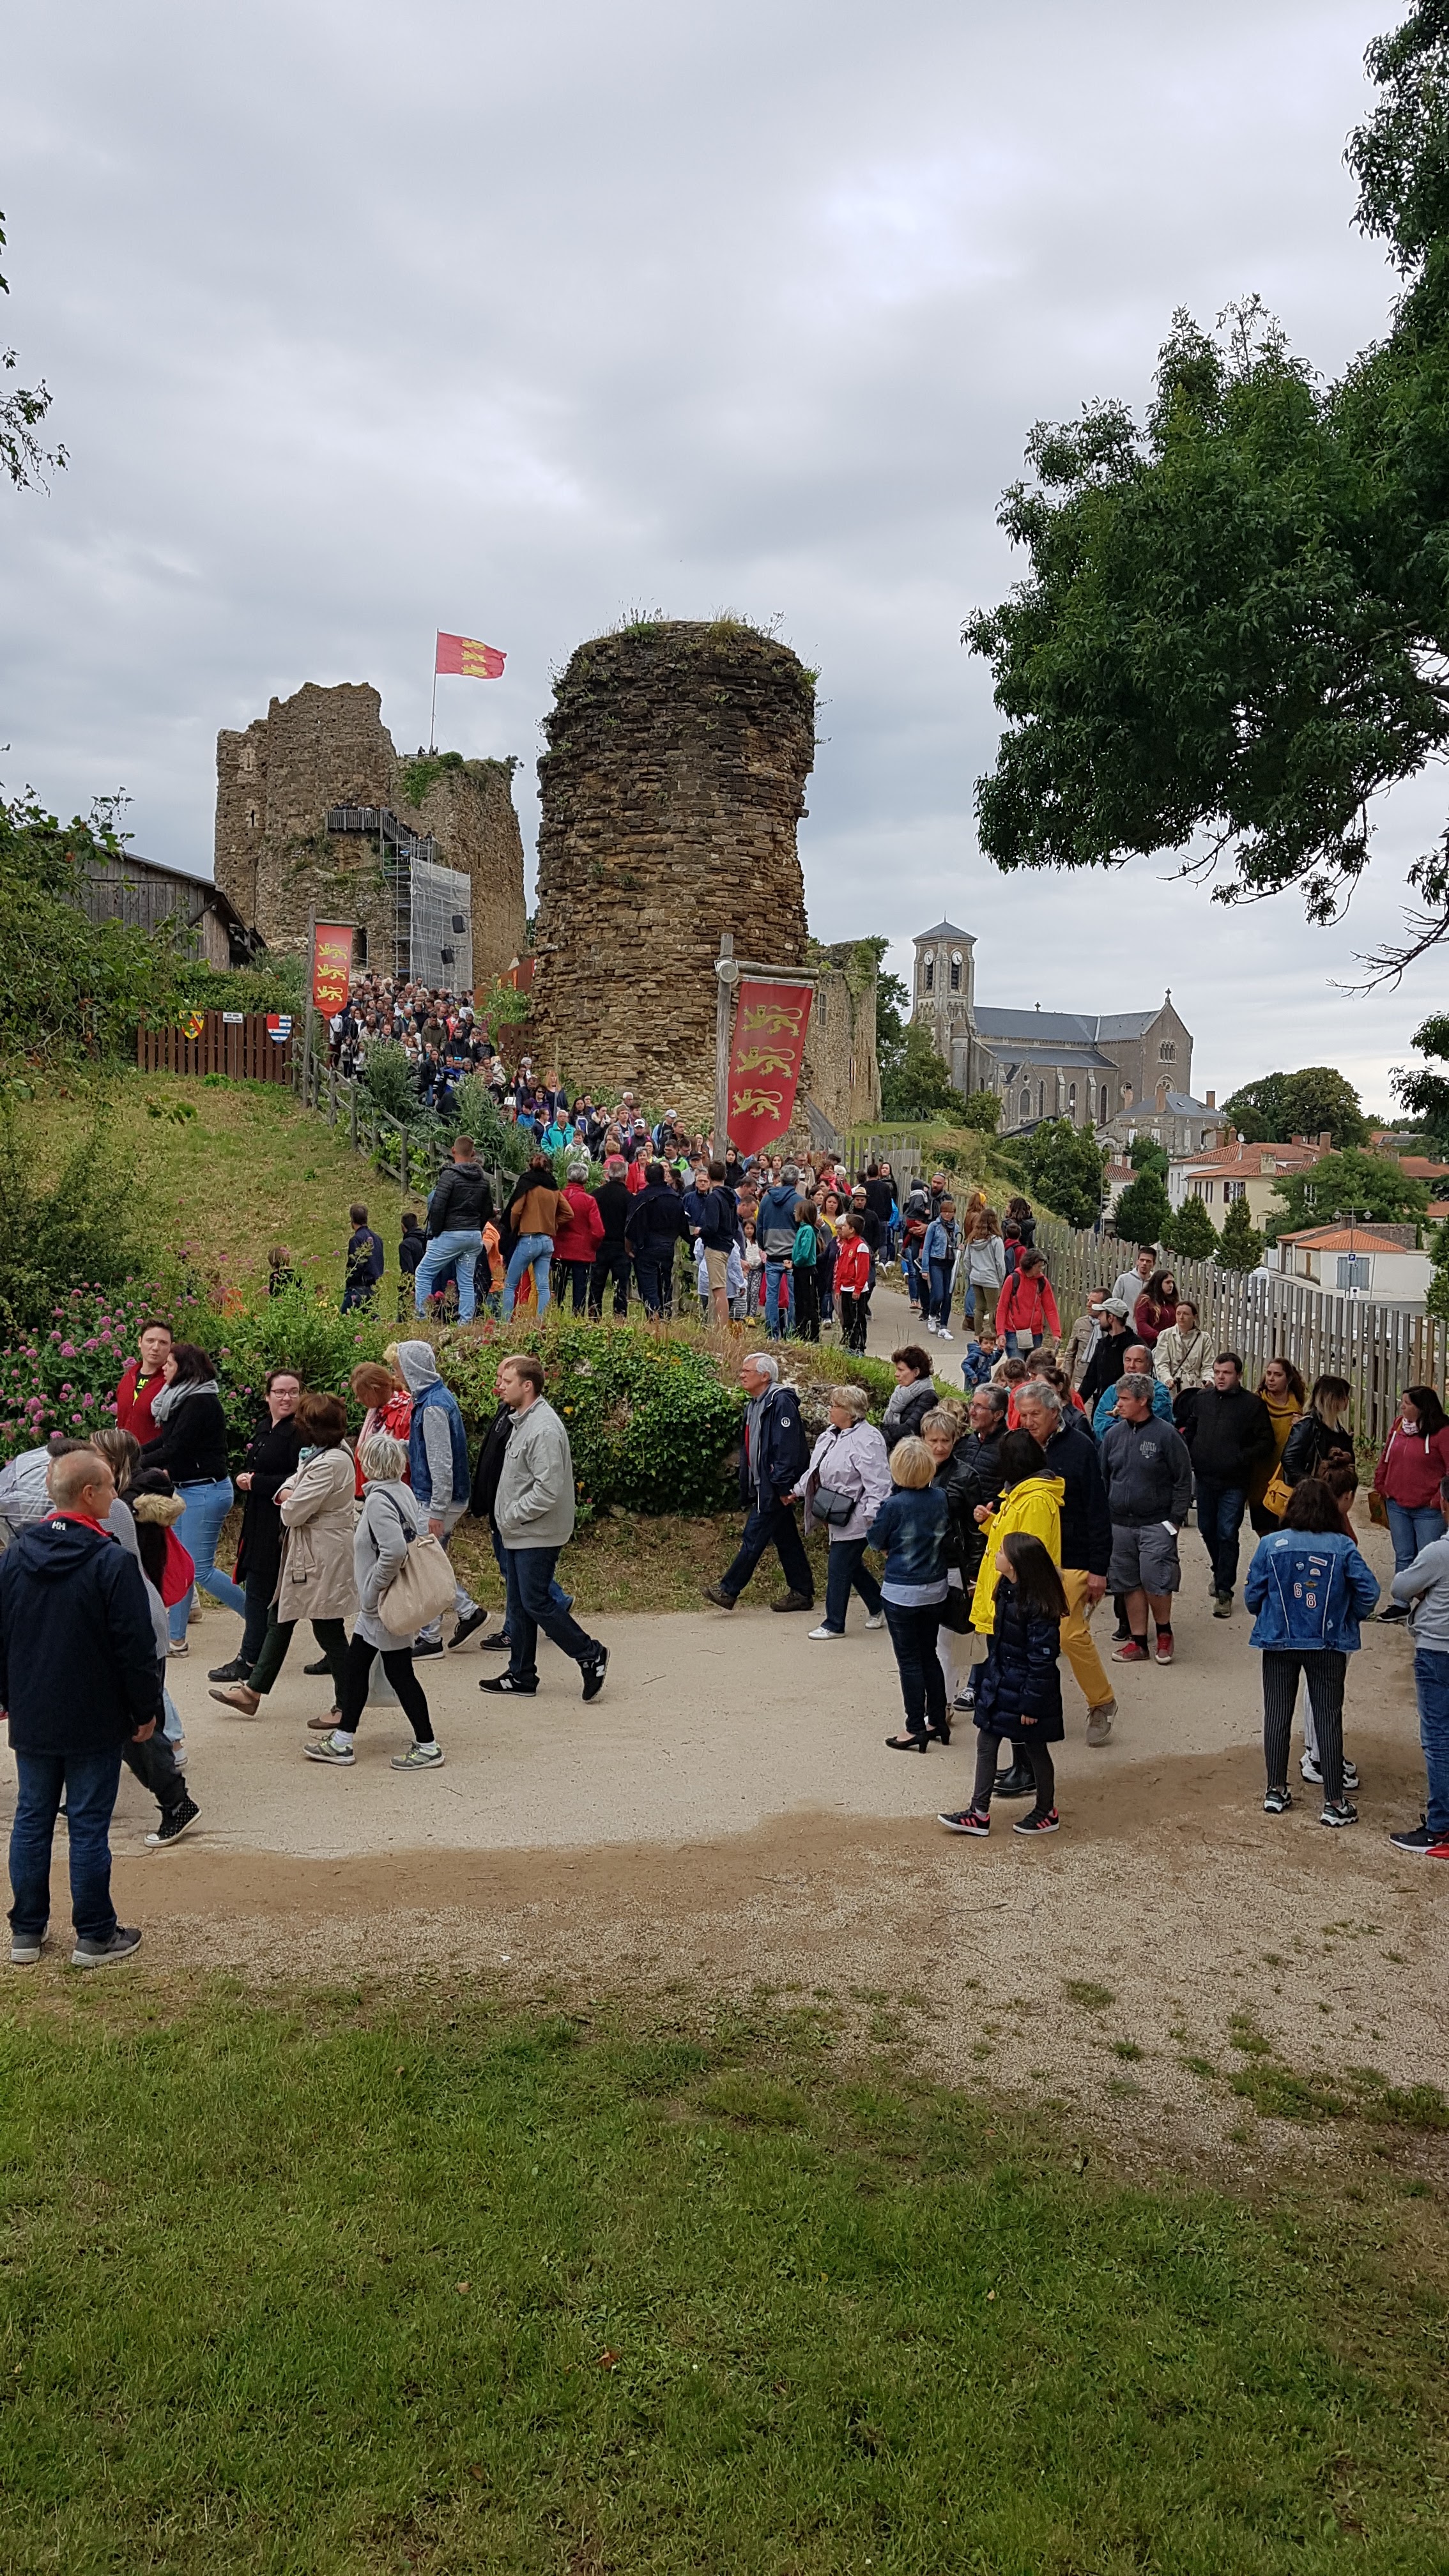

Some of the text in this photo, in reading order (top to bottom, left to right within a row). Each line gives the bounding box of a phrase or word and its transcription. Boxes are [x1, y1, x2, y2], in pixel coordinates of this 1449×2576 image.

[51, 1521, 66, 1531] HH
[1294, 1583, 1302, 1598] 6
[1306, 1593, 1316, 1607] 8
[500, 1678, 513, 1689] N
